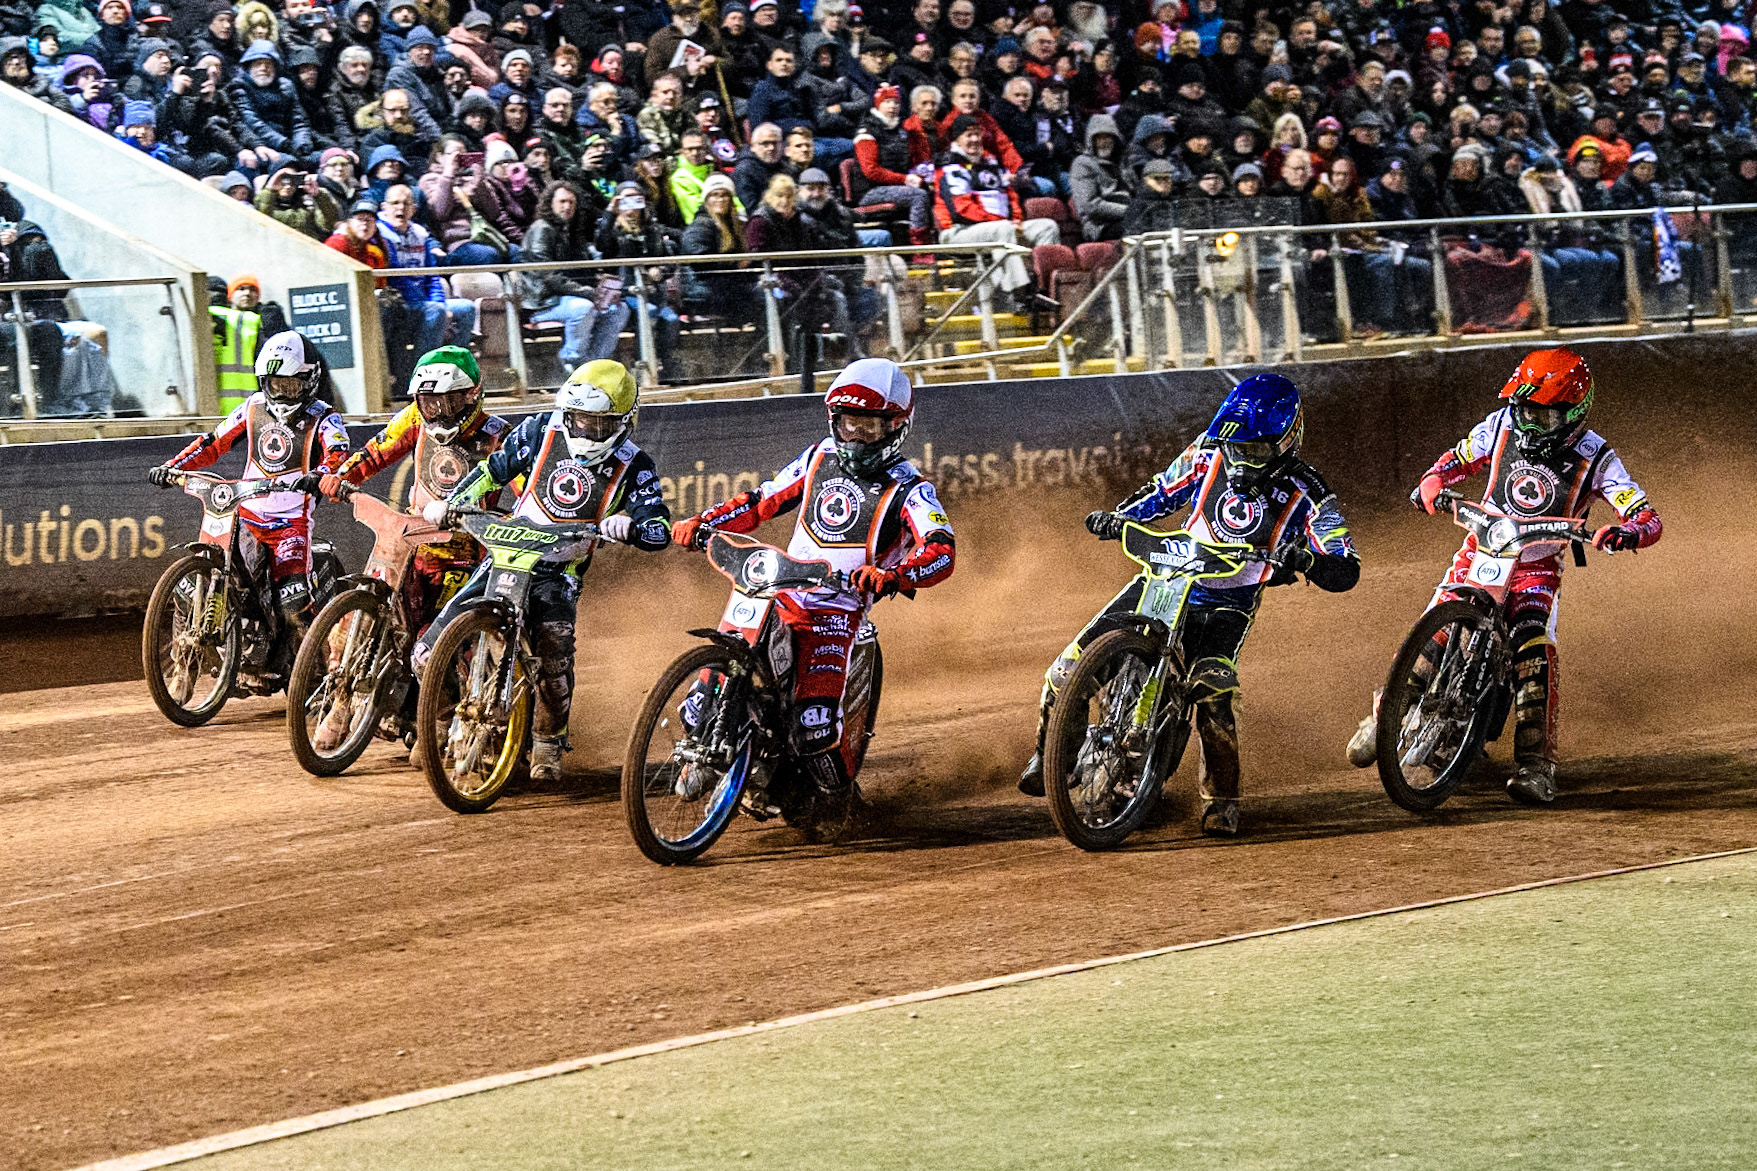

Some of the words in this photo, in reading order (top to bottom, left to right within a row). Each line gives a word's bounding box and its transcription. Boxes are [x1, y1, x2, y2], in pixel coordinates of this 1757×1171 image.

[292, 293, 328, 307] BLOCK
[327, 291, 338, 305] C
[296, 420, 305, 430] 4
[597, 464, 613, 478] 14
[1562, 461, 1574, 473] 7
[821, 477, 844, 488] PETER
[844, 478, 866, 503] CRAVEN
[821, 486, 838, 499] BELLE
[869, 482, 883, 495] 2
[1271, 486, 1290, 504] 16
[542, 497, 577, 518] MEMORIAL
[810, 520, 847, 542] MEMORIAL
[1211, 520, 1247, 543] MEMORIAL
[279, 583, 308, 598] DVR
